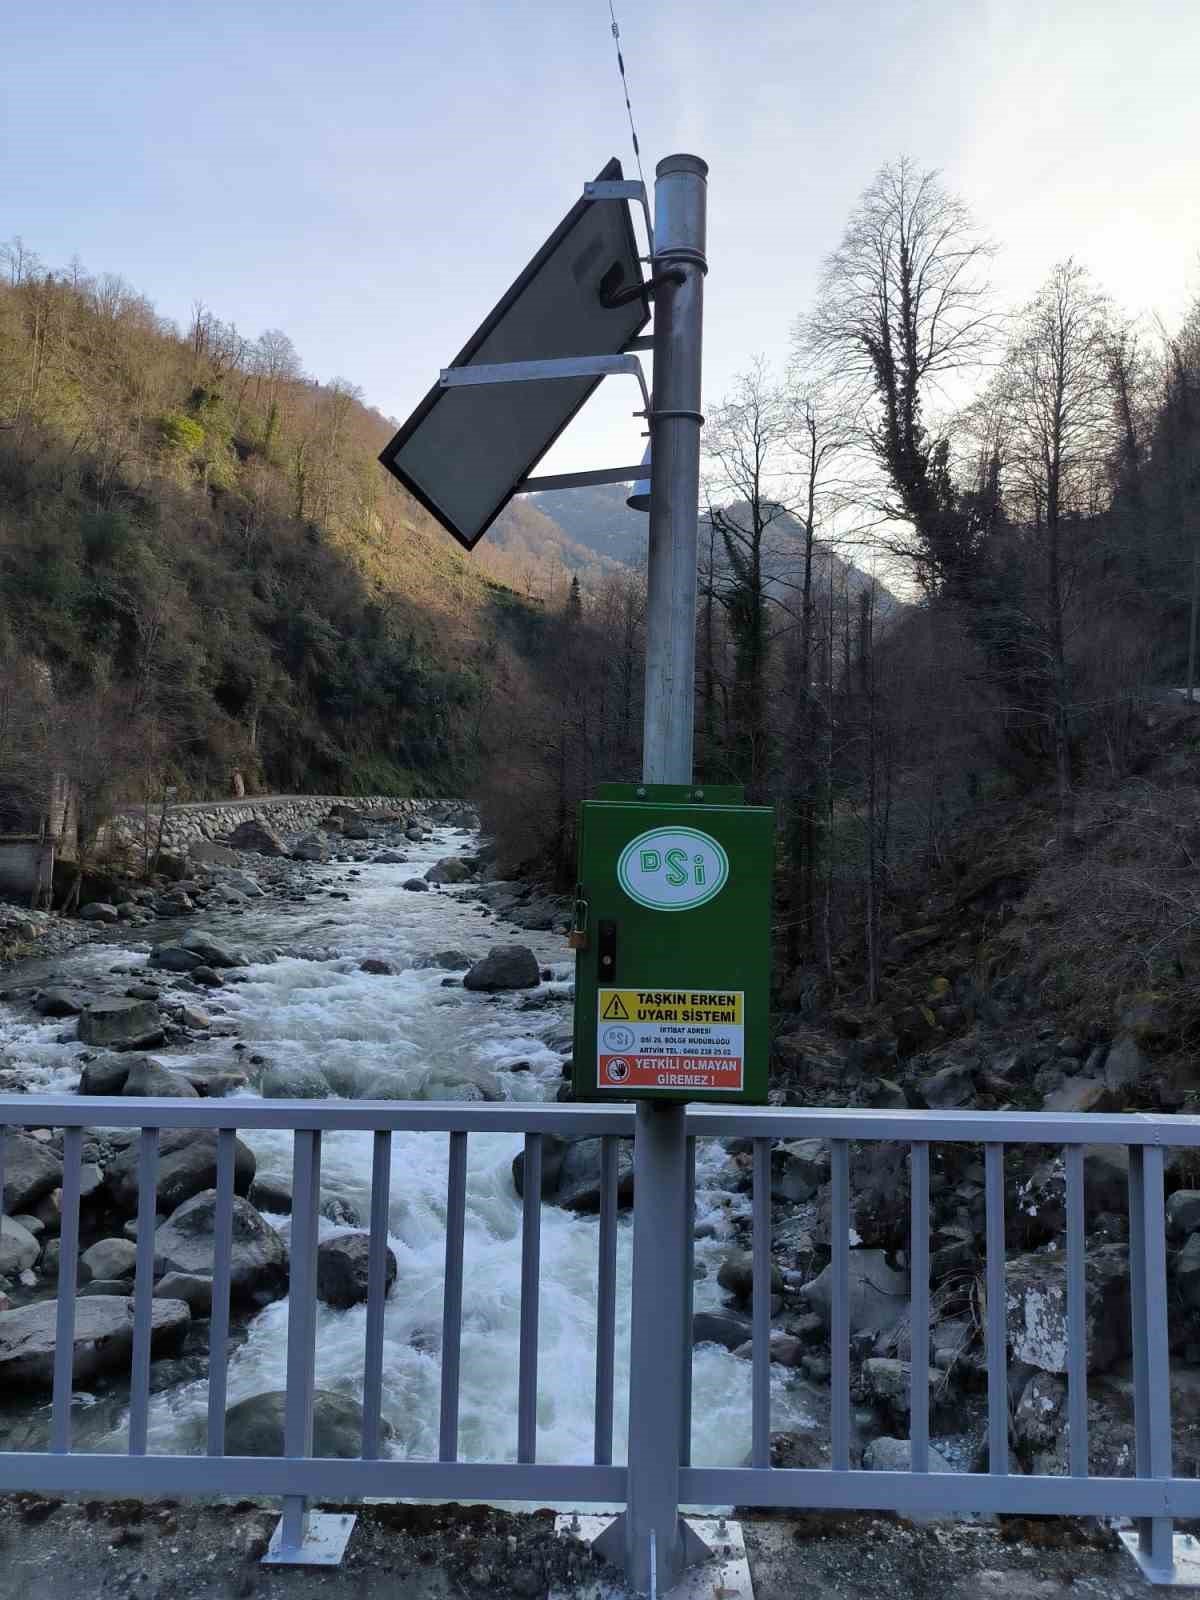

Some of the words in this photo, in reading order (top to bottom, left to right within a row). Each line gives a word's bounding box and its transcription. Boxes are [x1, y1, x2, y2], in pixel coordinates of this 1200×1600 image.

[637, 993, 685, 1007] TAŞKIN
[691, 994, 736, 1006] ERKEN
[637, 1009, 677, 1021] UYARI
[682, 1009, 735, 1022] SİSTEMİ
[635, 1058, 680, 1070] YETKİLİ
[683, 1060, 736, 1072] OLMAYAN
[657, 1073, 710, 1086] GİREMEZ
